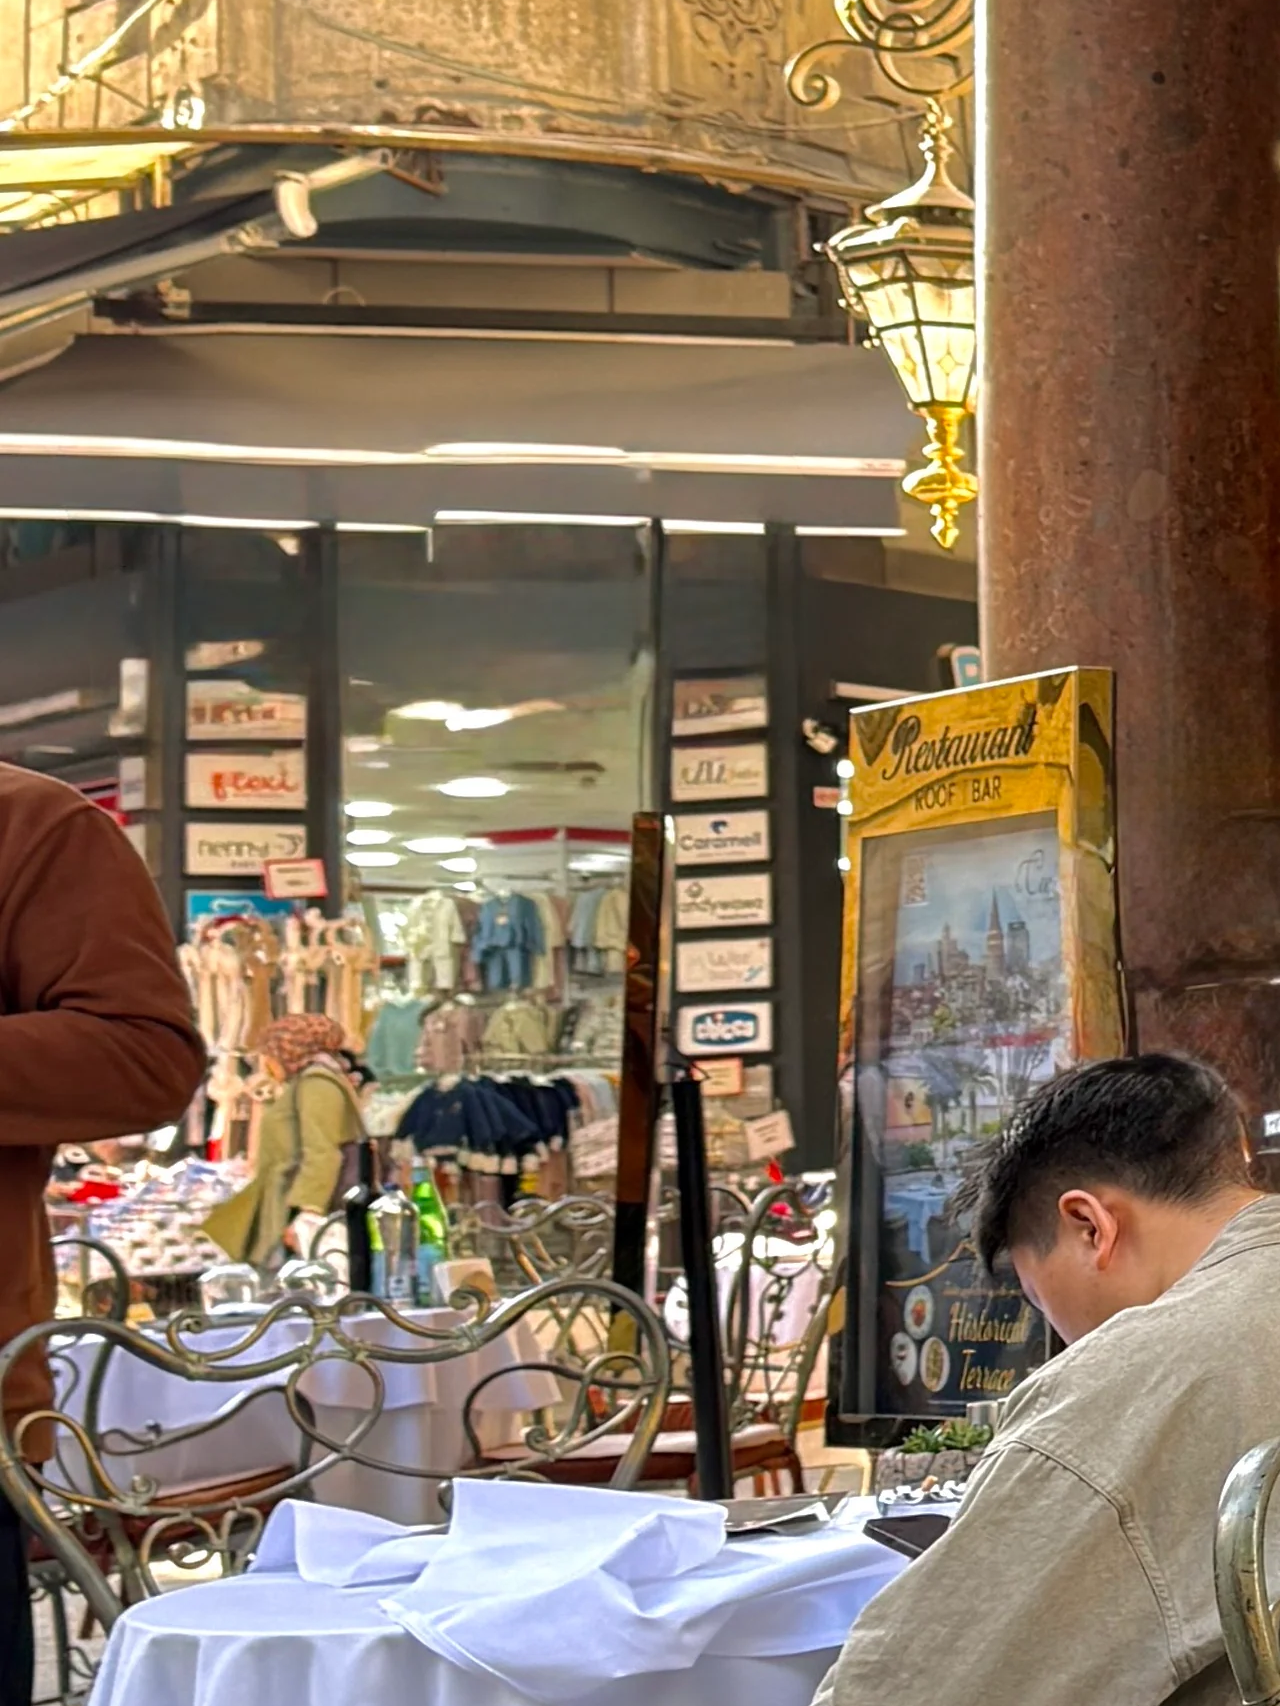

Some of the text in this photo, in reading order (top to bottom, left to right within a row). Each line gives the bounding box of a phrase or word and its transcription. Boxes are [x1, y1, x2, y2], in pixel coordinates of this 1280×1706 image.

[882, 716, 1038, 781] Restaurant
[971, 775, 1003, 803] BAR
[960, 1349, 1015, 1392] Terrace
